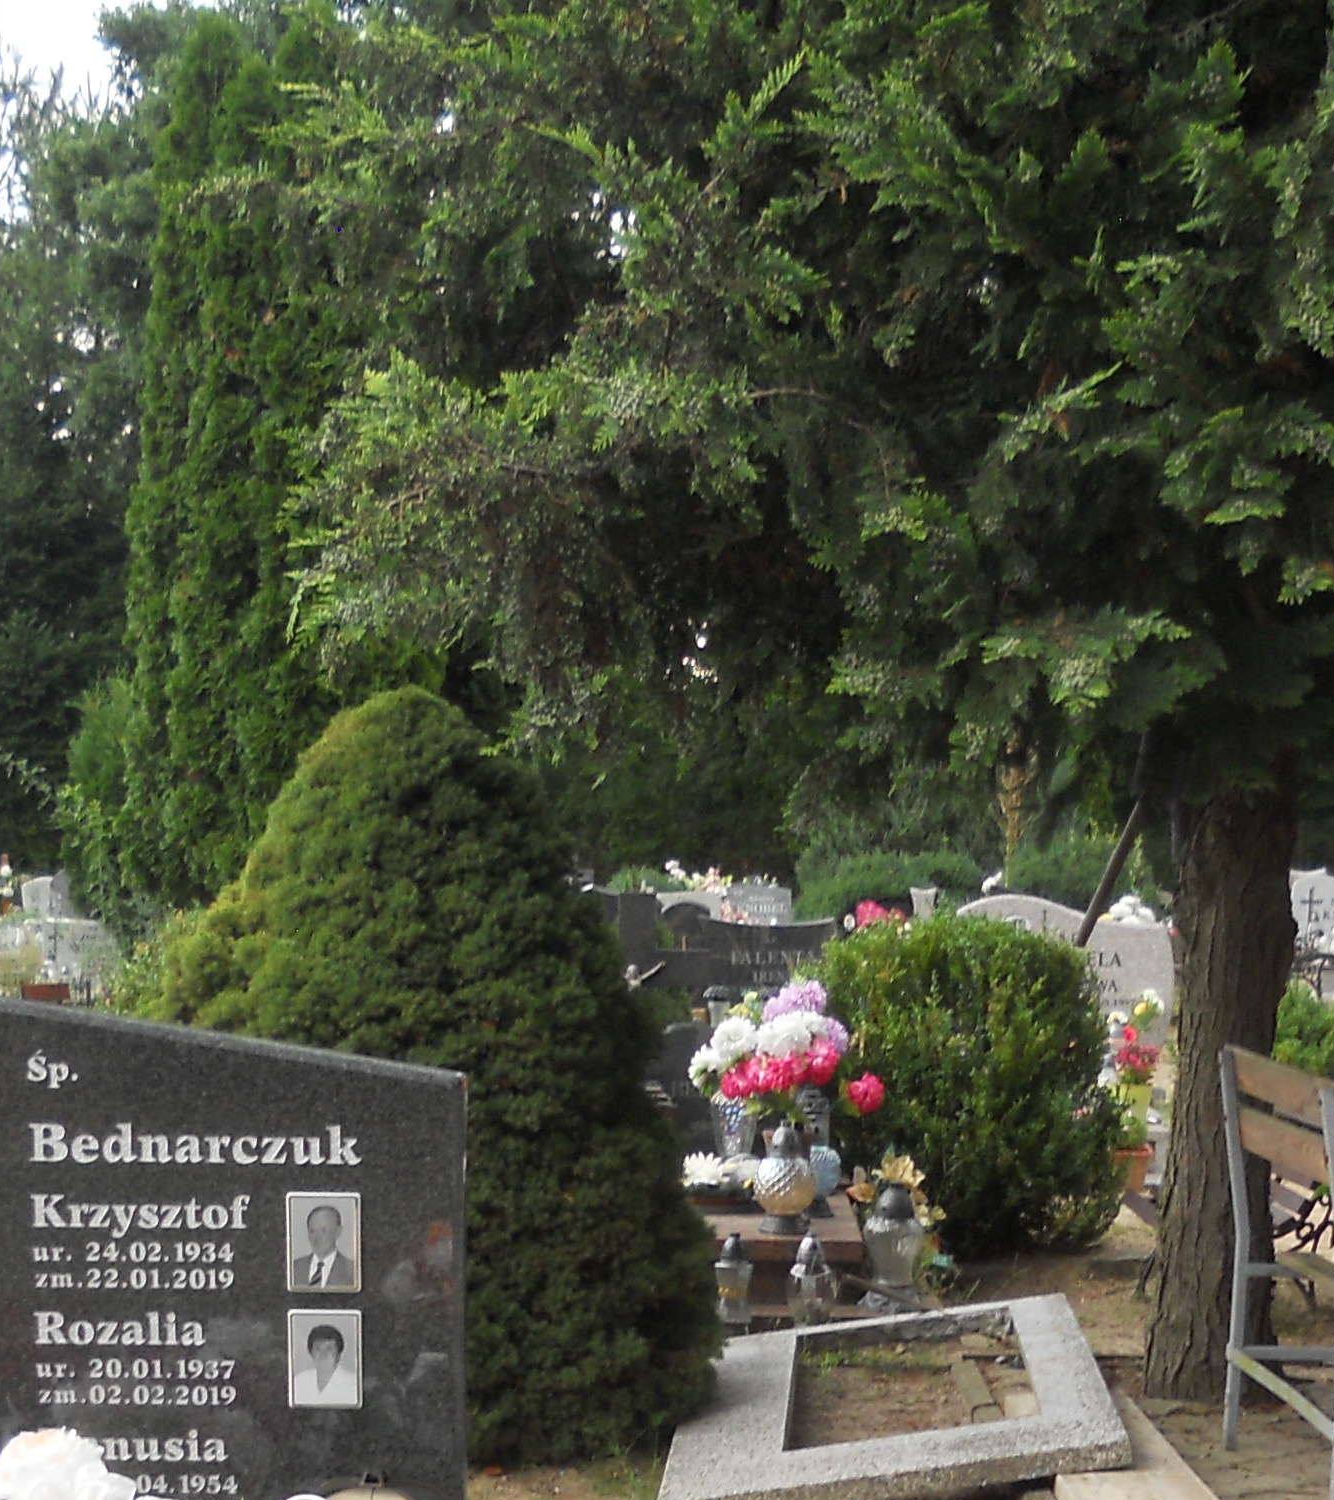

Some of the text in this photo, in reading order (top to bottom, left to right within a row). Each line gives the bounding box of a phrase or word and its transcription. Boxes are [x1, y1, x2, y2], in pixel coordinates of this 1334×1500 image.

[26, 1049, 79, 1089] Śp.
[29, 1122, 362, 1166] Bednarczuk
[30, 1193, 251, 1238] Krzysztof
[32, 1242, 234, 1263] ur. 24.02.1934
[33, 1311, 207, 1346] Rozalia
[35, 1358, 236, 1380] ur. 20.01.1937
[100, 1429, 229, 1463] nusia
[135, 1474, 240, 1494] 04.1954
